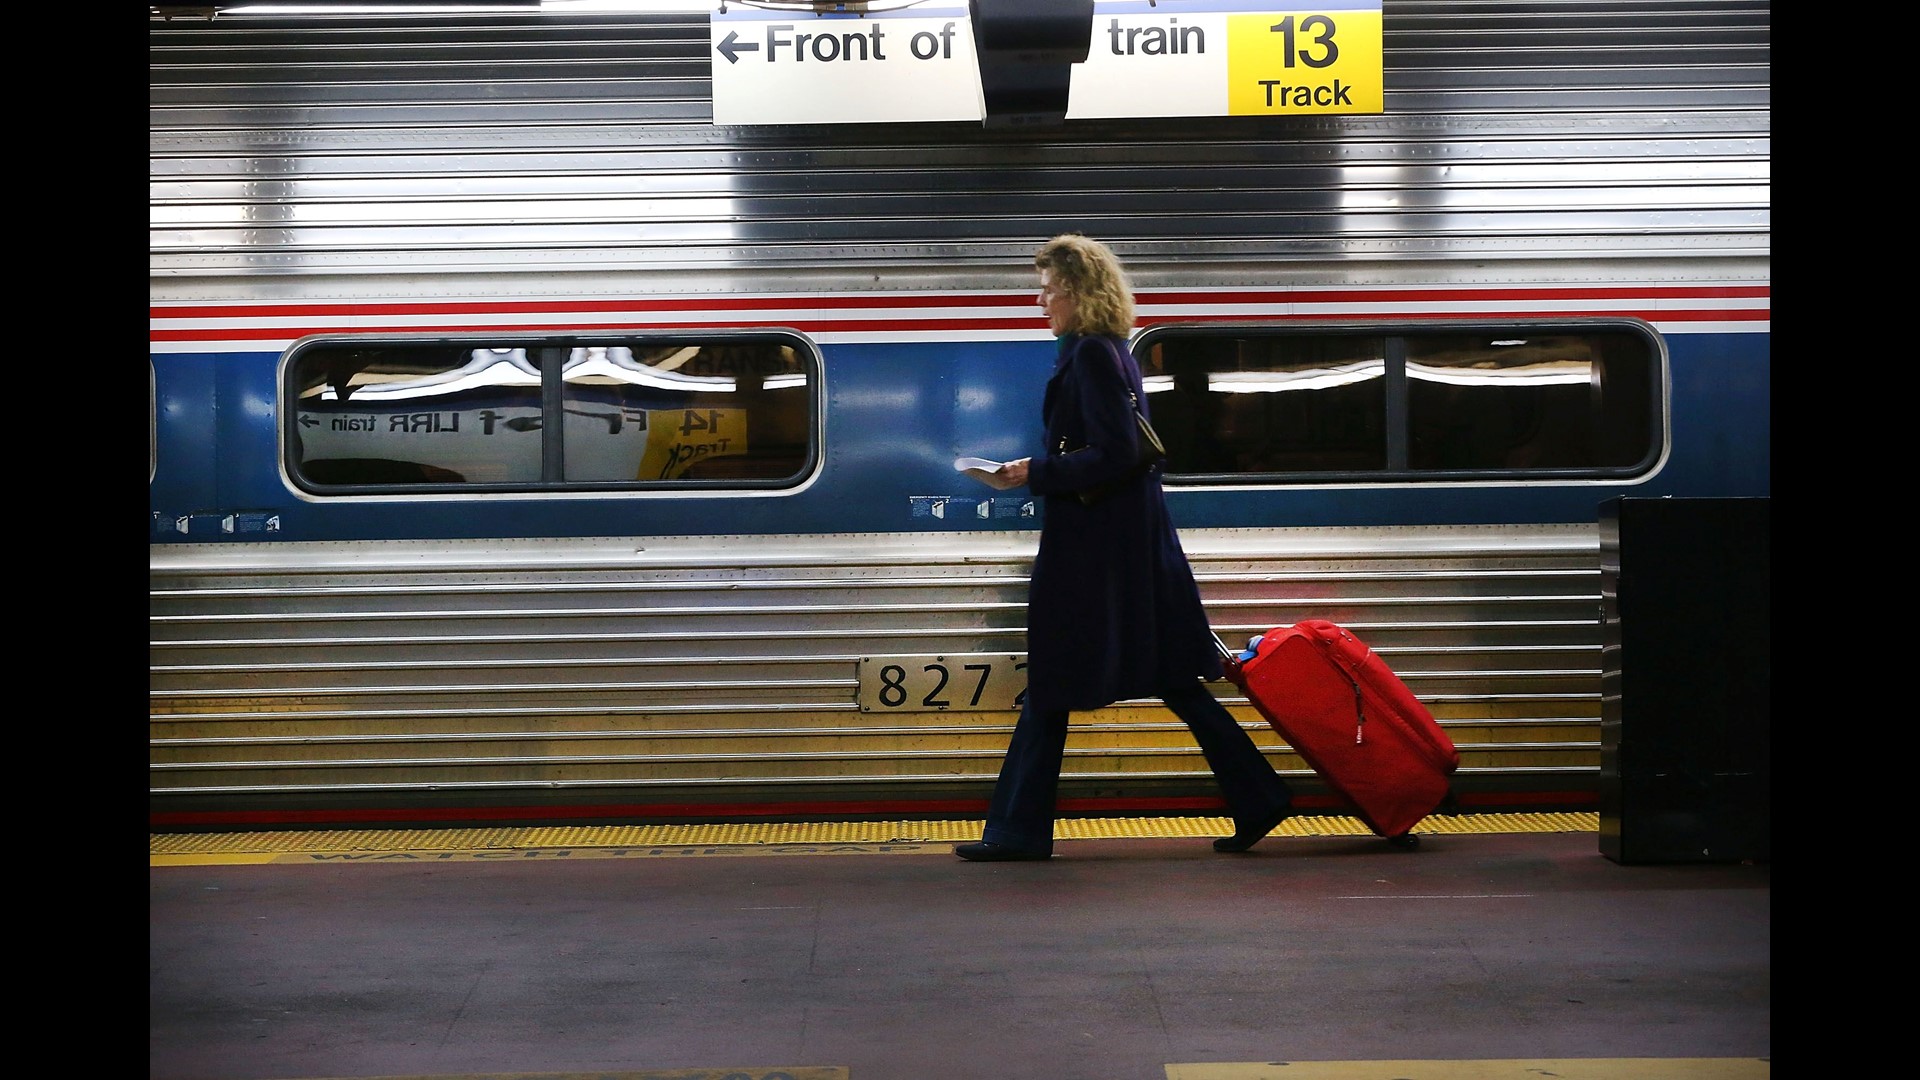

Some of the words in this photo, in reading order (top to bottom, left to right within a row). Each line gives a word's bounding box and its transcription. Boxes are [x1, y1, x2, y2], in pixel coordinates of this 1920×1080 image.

[766, 22, 887, 63] Front
[910, 21, 956, 61] of
[1107, 17, 1206, 56] train
[1269, 14, 1340, 69] 13
[1257, 79, 1353, 107] Track
[310, 850, 573, 860] WATCH
[767, 845, 921, 853] GAP
